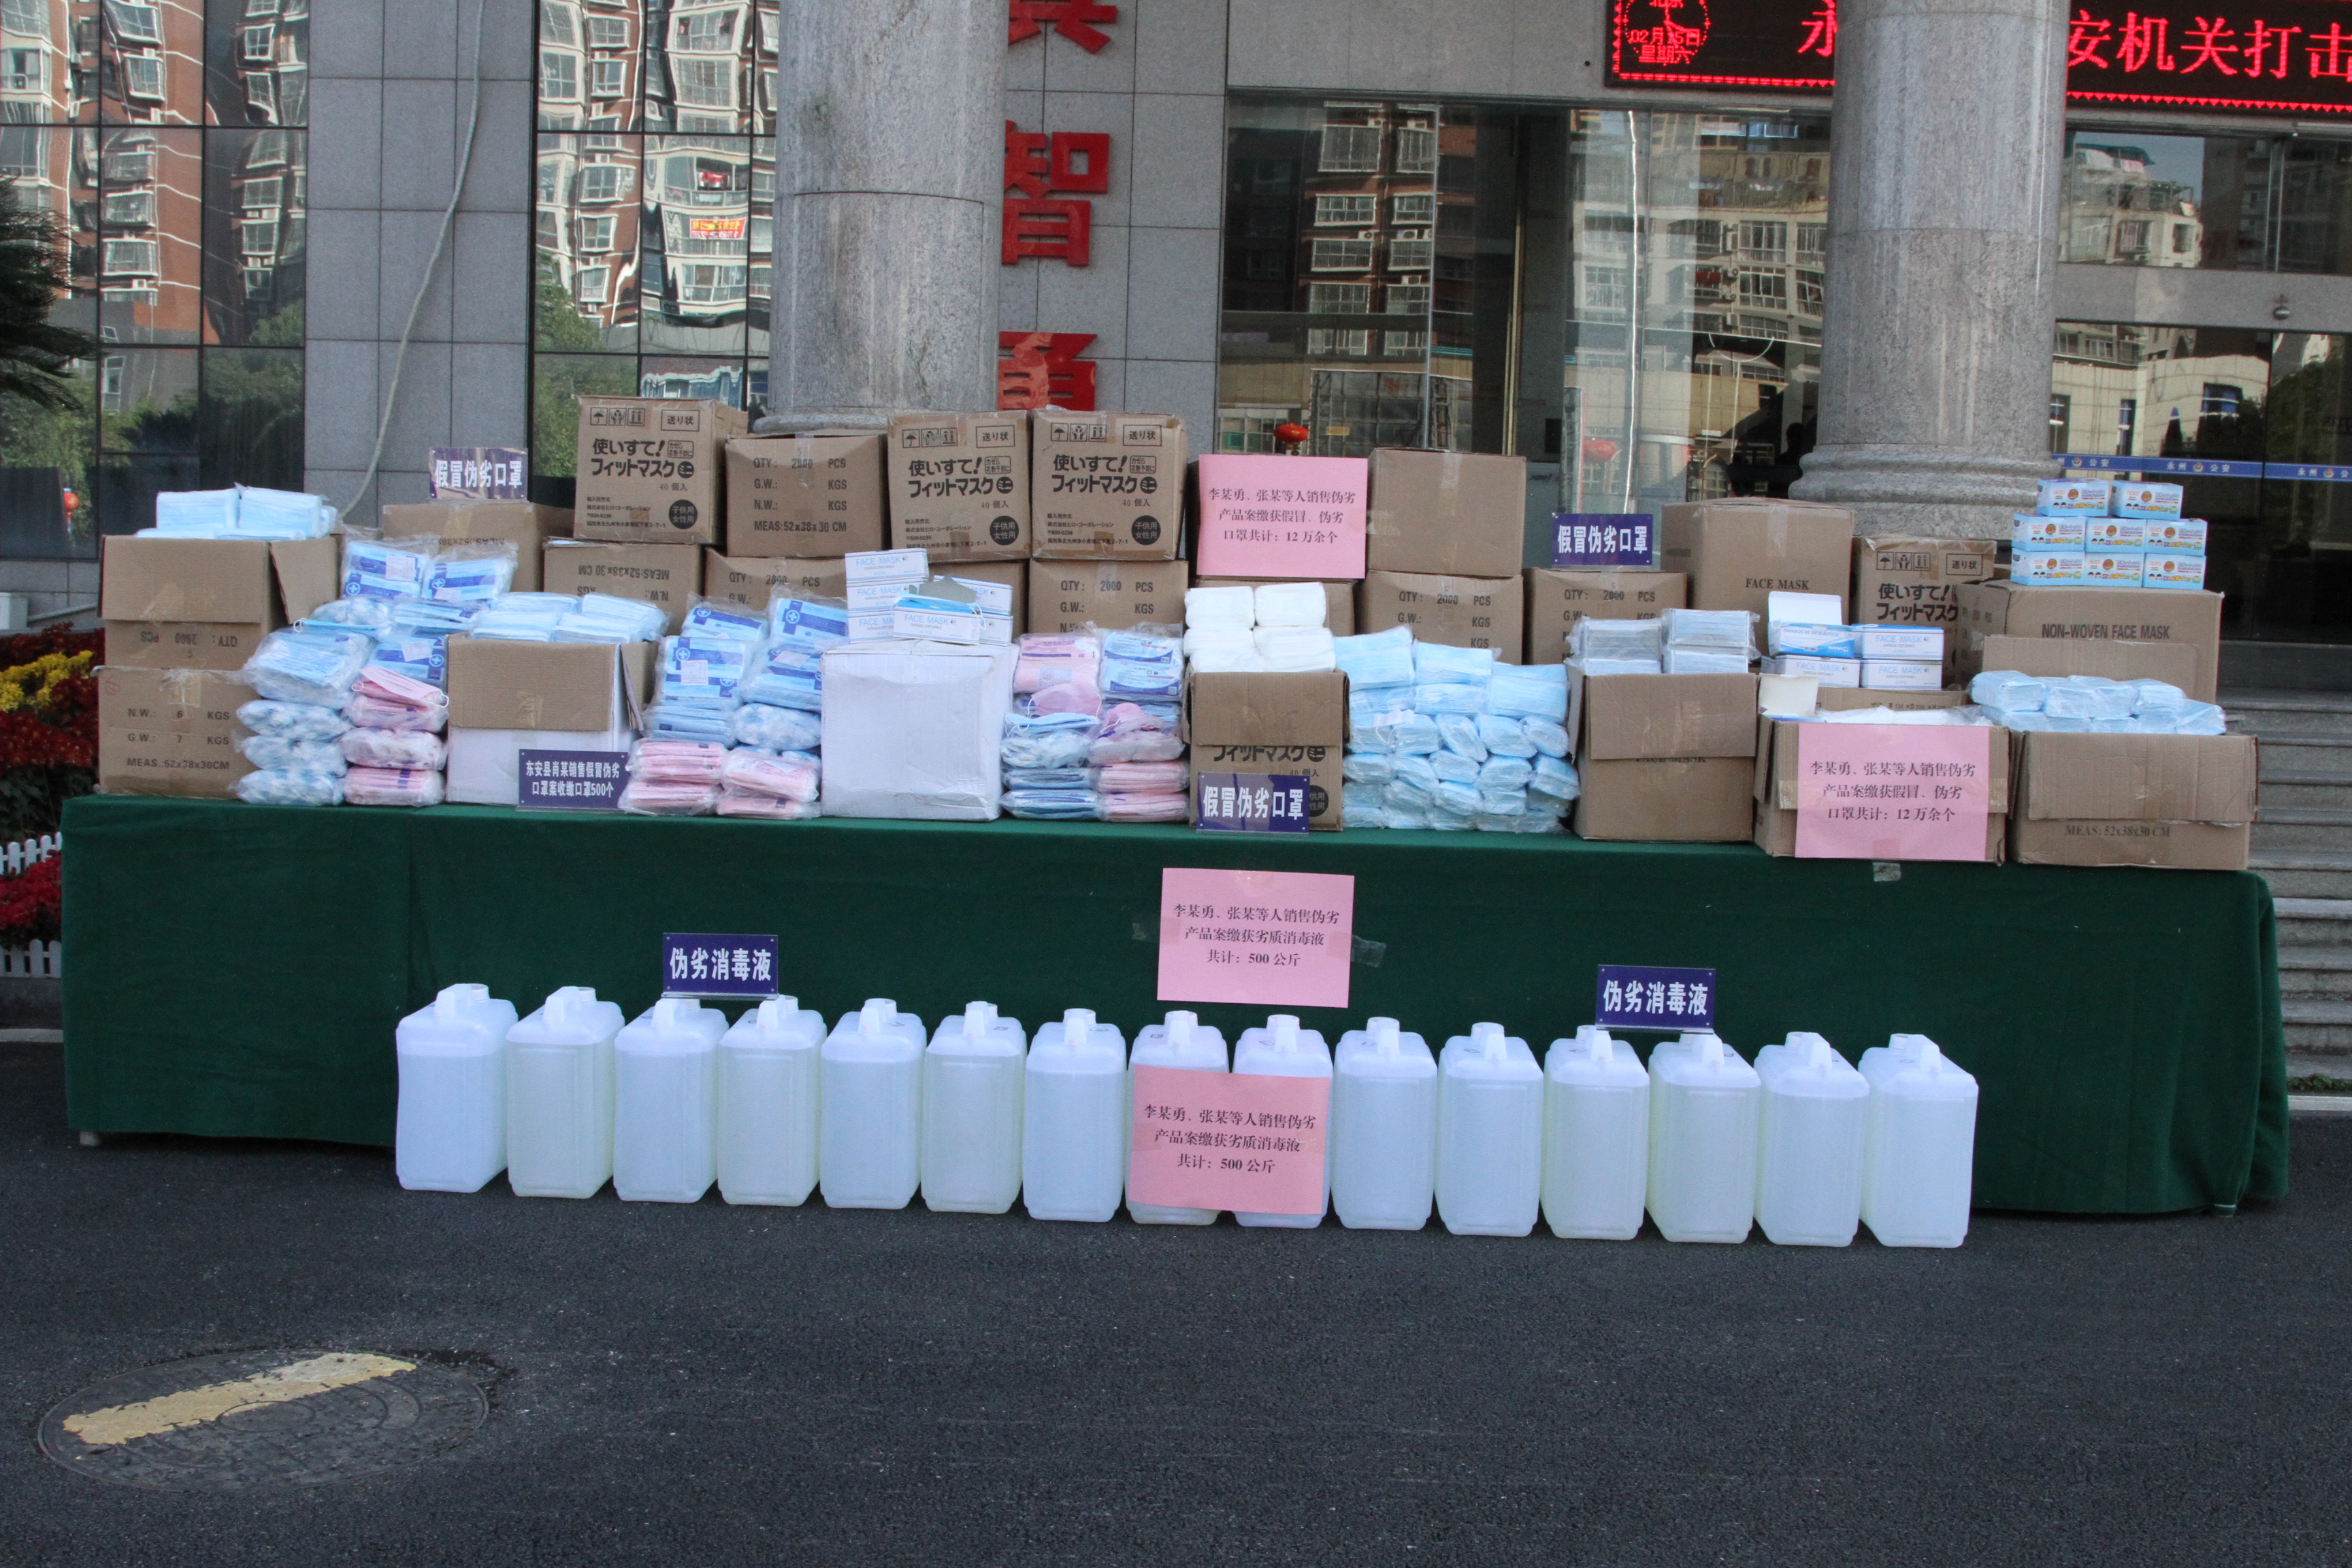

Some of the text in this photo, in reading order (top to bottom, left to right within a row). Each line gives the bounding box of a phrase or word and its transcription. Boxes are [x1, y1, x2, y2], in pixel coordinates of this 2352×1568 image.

[2068, 10, 2352, 82] 安机关打击
[1639, 44, 1693, 64] 星期六
[668, 415, 693, 425] 送り状
[982, 431, 1009, 442] 送り状
[1129, 430, 1156, 440] 送り状
[591, 458, 675, 478] フィットマスク
[828, 458, 846, 468] PCS
[435, 459, 523, 489] 假冒伪劣口罩
[828, 479, 847, 490] KGS
[908, 476, 994, 498] フィットマスク
[1051, 474, 1137, 494] フィットマスク
[1208, 487, 1356, 504] 李某勇、张某等人销售伪劣
[672, 506, 694, 514] 子供用
[828, 500, 847, 510] KGS
[672, 515, 694, 523] 女性用
[1219, 508, 1343, 524] 产品案缴获假冒、伪劣
[993, 521, 1015, 530] 子供用
[1134, 521, 1157, 529] 子供用
[994, 531, 1016, 540] 女性用
[1135, 531, 1158, 540] 女性用
[1558, 525, 1648, 554] 假冒伪劣口罩
[879, 556, 901, 564] MASK
[802, 576, 820, 587] PCS
[1100, 581, 1122, 591] 2000
[1135, 581, 1154, 592] PCS
[1746, 577, 1810, 591] FACE MASK
[881, 586, 902, 594] MASK
[1437, 593, 1458, 604] 2000
[1473, 595, 1490, 606] PCS
[1638, 591, 1655, 602] PCS
[1134, 603, 1154, 614] KGS
[1876, 602, 1959, 622] フィットマスク
[904, 614, 949, 625] FACE MASK
[1472, 616, 1490, 627] KGS
[140, 630, 159, 643] PCS
[2042, 623, 2170, 640] NON-WOVEN FACE MASK
[1471, 637, 1489, 649] KGS
[1797, 662, 1841, 671] FACE MASK
[1878, 666, 1923, 674] FACE MASK
[208, 710, 229, 721] KGS
[207, 735, 229, 745] KGS
[1809, 761, 1976, 778] 李某勇、张某等人销售伪劣
[1309, 792, 1325, 801] 供用
[1823, 783, 1962, 800] 产品案缴获假冒、伪劣
[1203, 785, 1304, 821] 假冒伪劣口罩
[1309, 802, 1325, 811] 性用
[1173, 903, 1339, 925] 李某勇、张某等人销售伪劣
[1185, 926, 1324, 946] 产品案缴获劣质消毒液
[669, 947, 772, 981] 伪劣消毒液
[1603, 979, 1709, 1016] 伪劣消毒液
[1143, 1104, 1316, 1130] 李某勇、张某等人销售伪劣
[1155, 1128, 1301, 1153] 产品案缴获劣质消毒液
